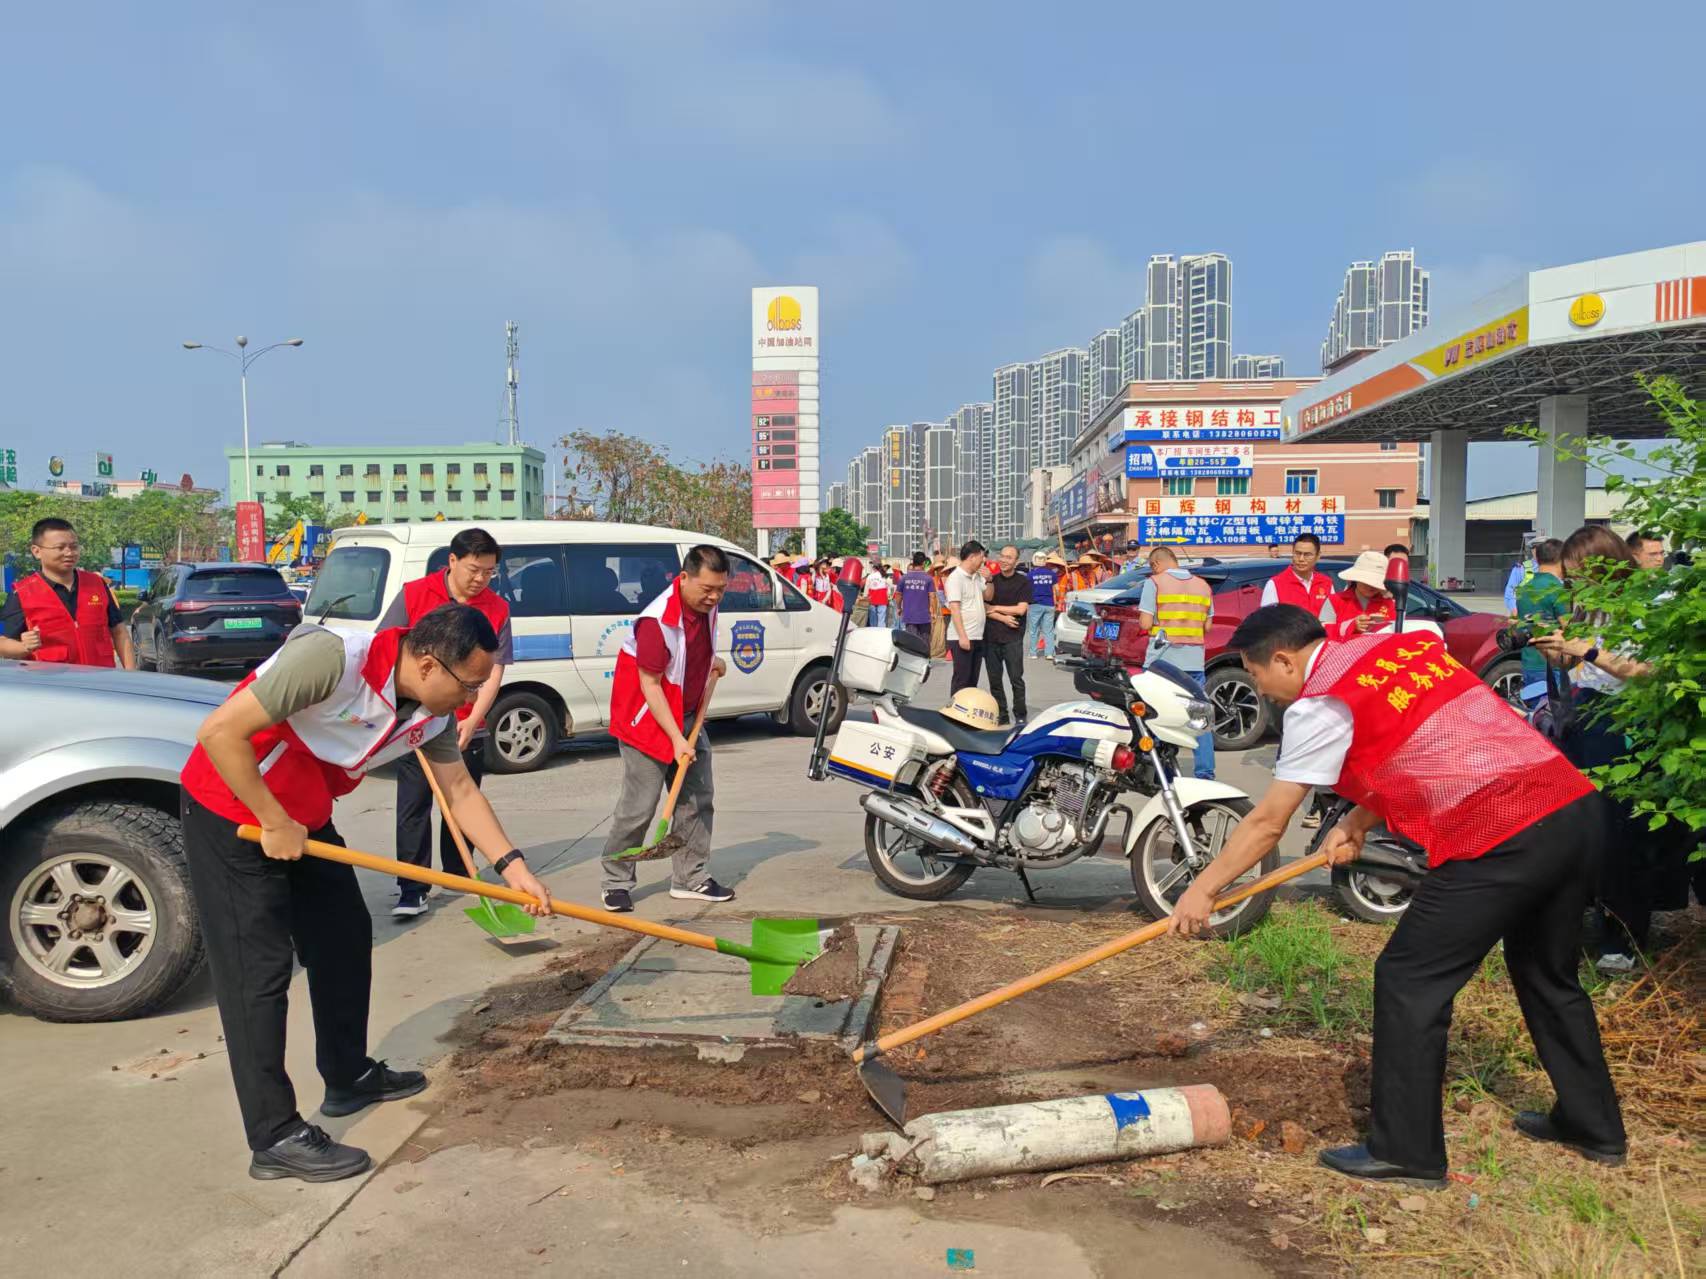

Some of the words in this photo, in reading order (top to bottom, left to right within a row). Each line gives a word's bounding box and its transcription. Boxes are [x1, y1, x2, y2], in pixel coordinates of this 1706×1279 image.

[1135, 409, 1280, 428] 承接钢结构工
[1129, 453, 1153, 466] 招聘
[1145, 499, 1337, 515] 国辉钢构材料
[1072, 709, 1108, 720] SUZUKI
[870, 742, 896, 760] 公安
